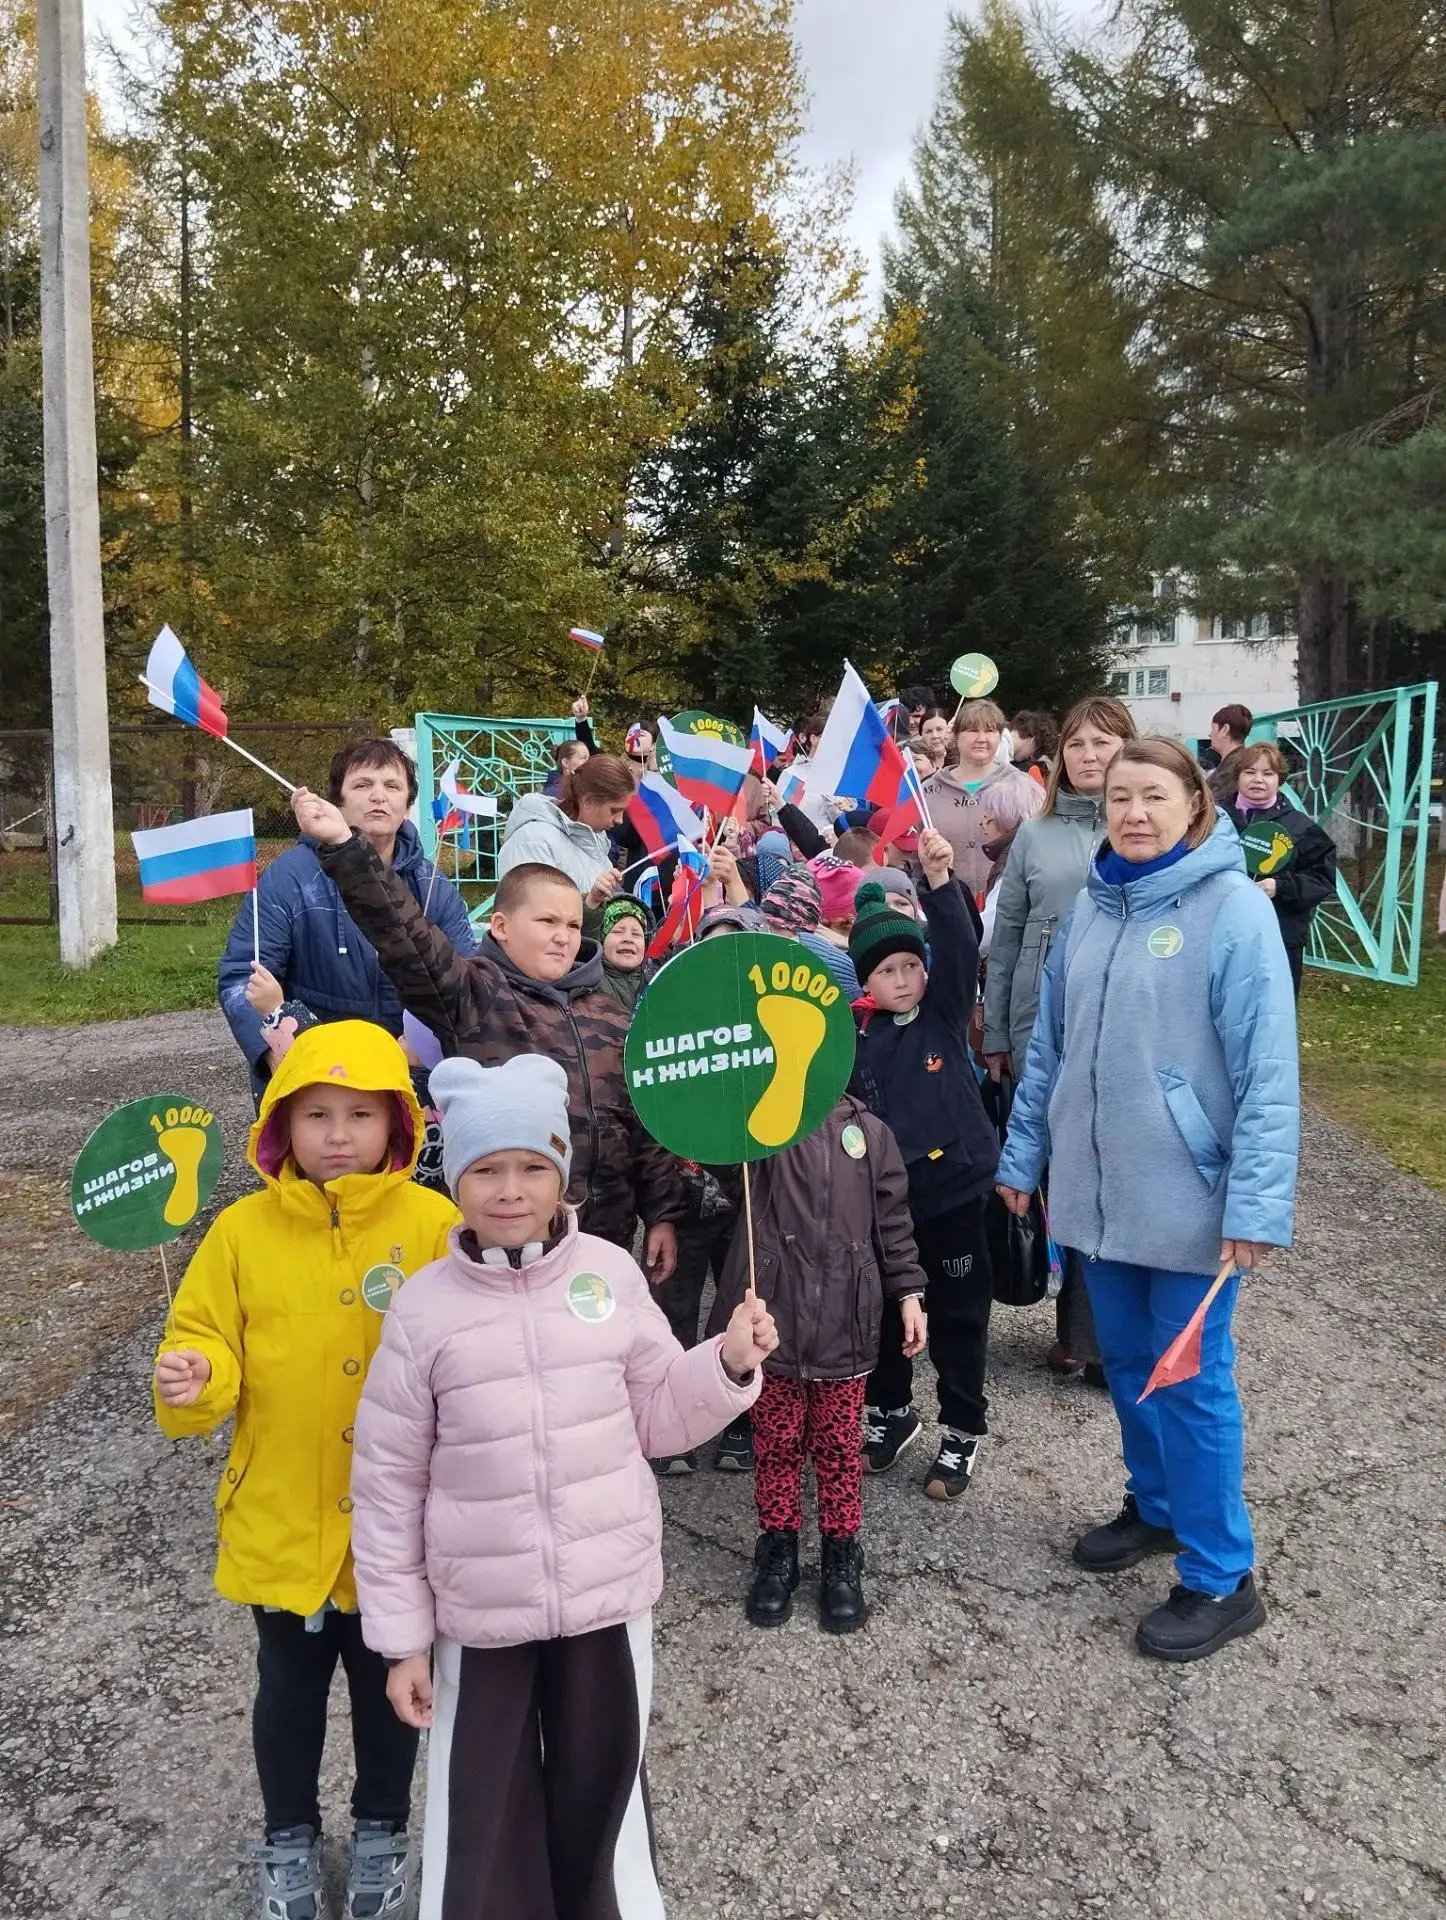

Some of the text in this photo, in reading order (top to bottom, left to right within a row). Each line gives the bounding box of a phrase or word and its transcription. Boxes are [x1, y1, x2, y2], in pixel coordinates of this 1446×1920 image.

[689, 718, 724, 733] 10000
[748, 961, 840, 1007] 10000
[645, 1023, 752, 1059] ШАГОВ
[632, 1046, 774, 1088] К ЖИЗНИ
[150, 1106, 214, 1133] 10000
[76, 1162, 175, 1216] К ЖИЗНИ
[83, 1152, 159, 1195] ШАГОВ
